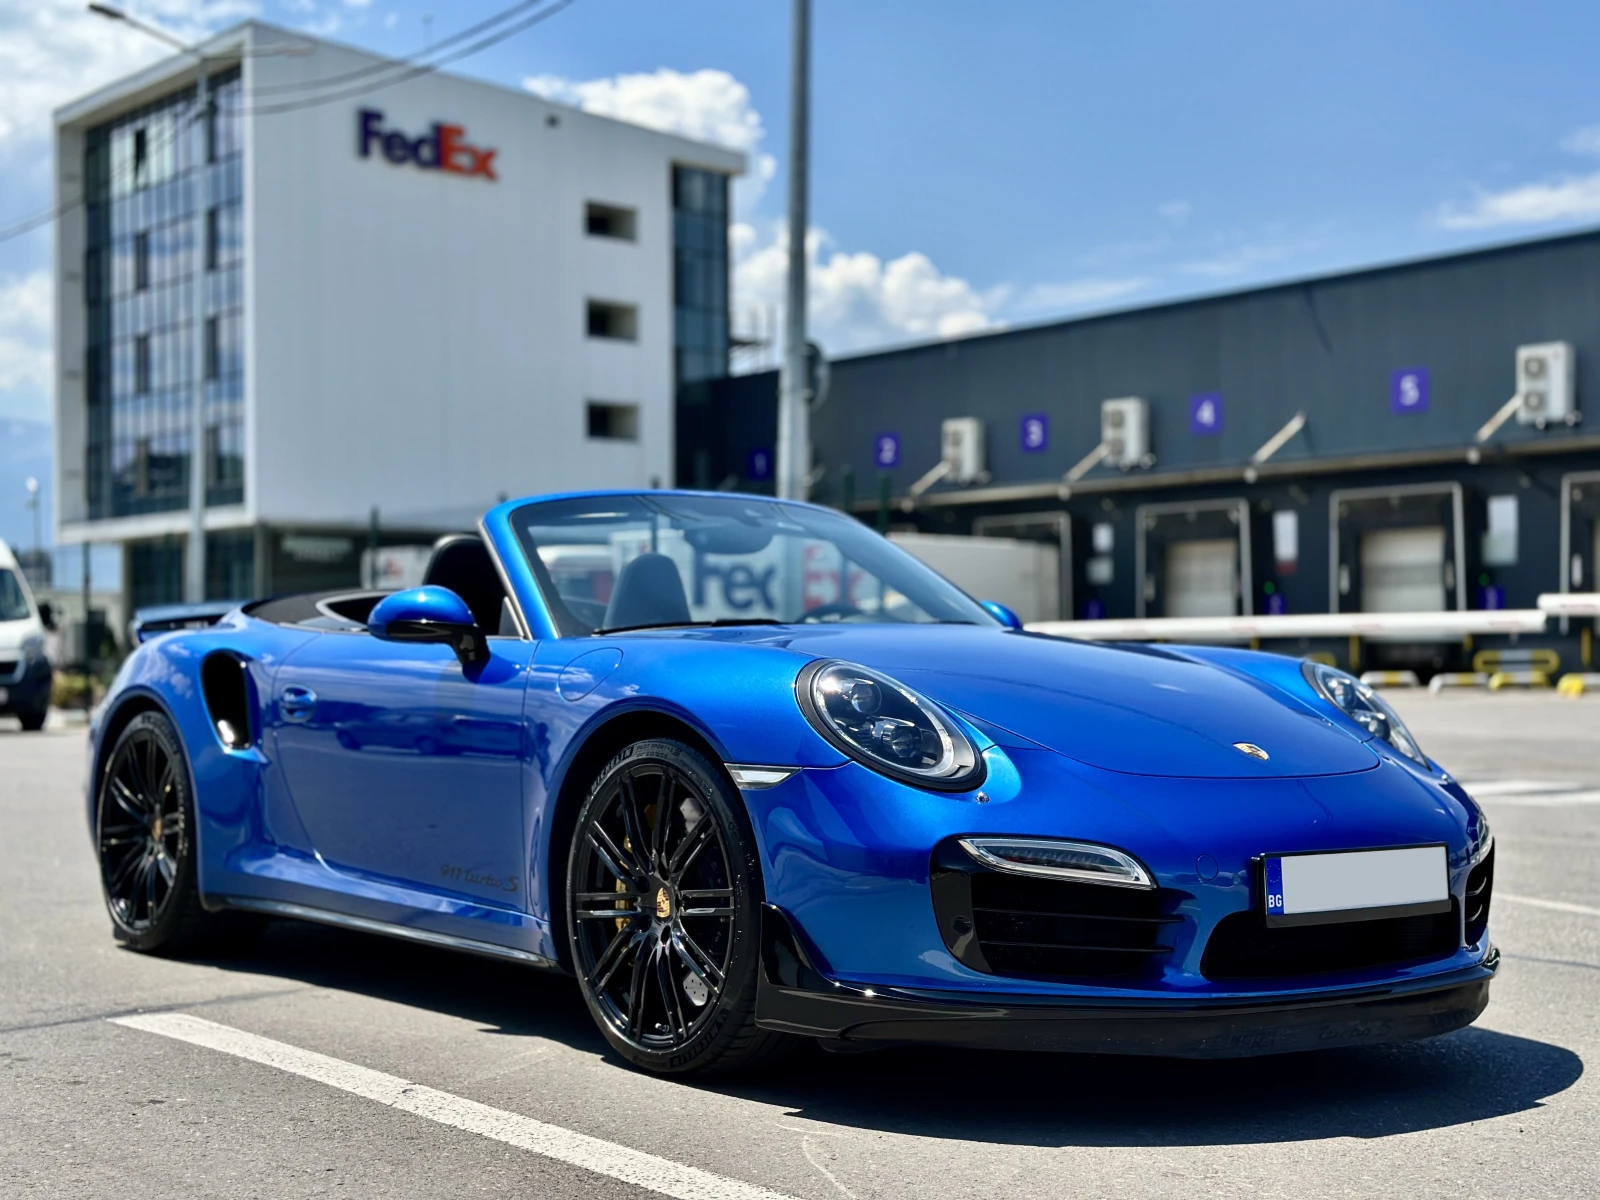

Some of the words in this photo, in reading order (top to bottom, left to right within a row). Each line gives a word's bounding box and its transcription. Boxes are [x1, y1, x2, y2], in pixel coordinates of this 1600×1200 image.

[356, 106, 499, 182] FedEx
[1399, 373, 1421, 407] 5
[1196, 398, 1216, 428] 4
[1024, 418, 1044, 448] 3
[878, 436, 897, 465] 2
[441, 864, 463, 880] 911
[502, 875, 519, 893] S
[1268, 893, 1282, 908] BG
